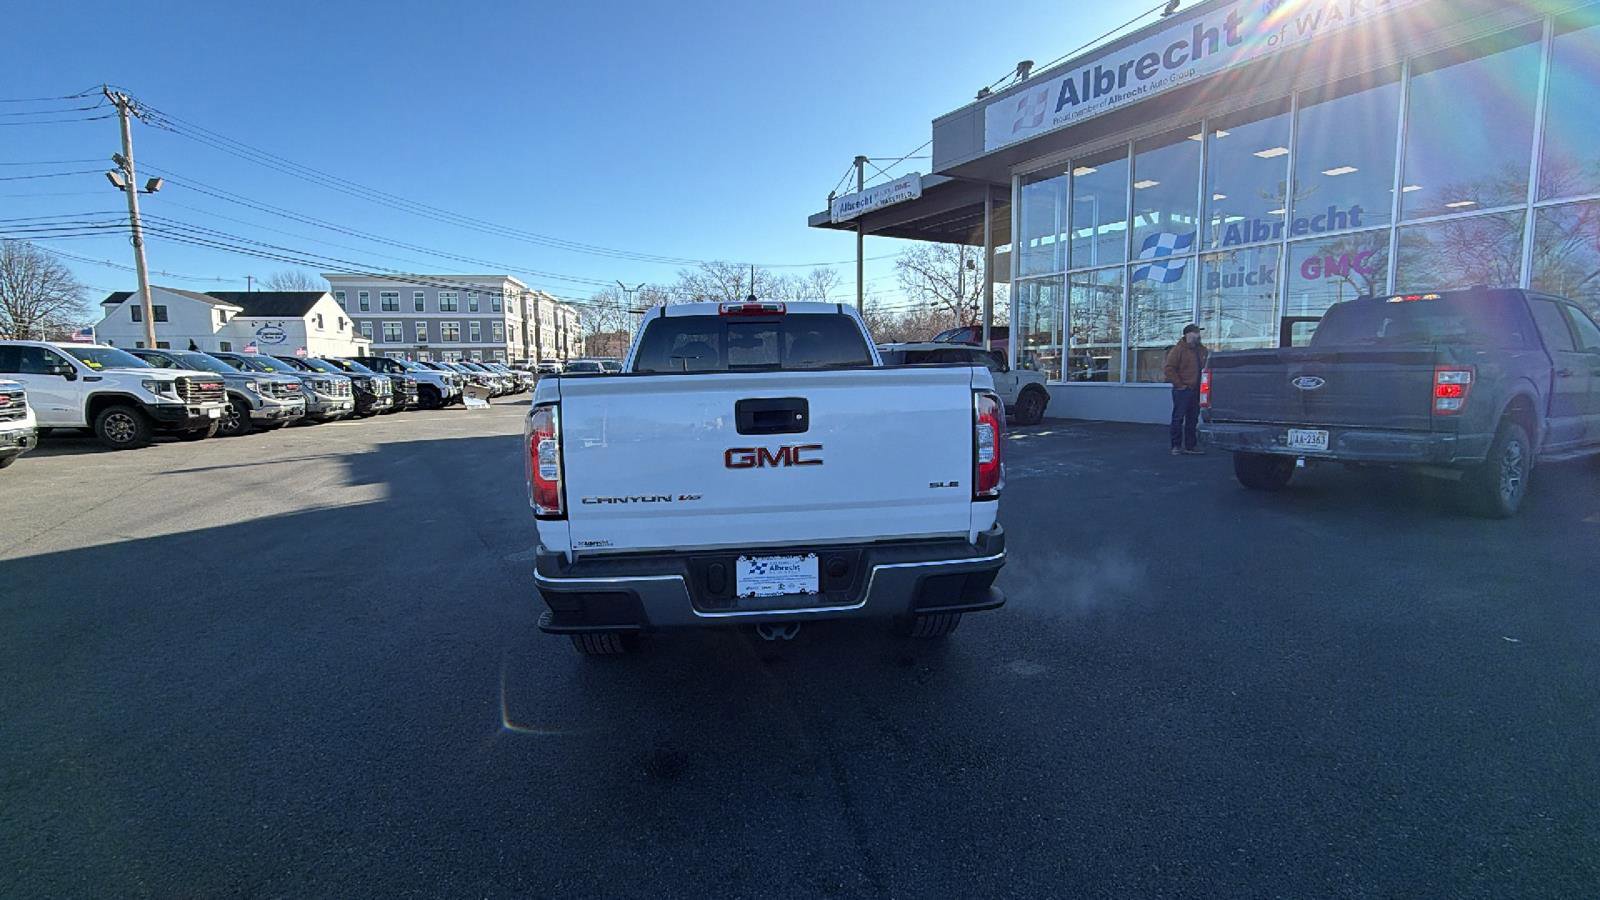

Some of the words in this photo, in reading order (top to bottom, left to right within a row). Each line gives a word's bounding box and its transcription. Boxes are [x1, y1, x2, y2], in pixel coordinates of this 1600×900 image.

[1267, 24, 1287, 46] of
[1054, 8, 1244, 114] Albrecht
[1053, 113, 1071, 125] Proud
[1071, 103, 1099, 120] member
[1099, 99, 1108, 108] of
[1108, 84, 1148, 106] Albrecht
[1150, 77, 1169, 91] Auto
[1169, 67, 1196, 84] Group
[840, 194, 873, 214] Albrecht
[1222, 204, 1364, 248] Albrecht
[1206, 265, 1275, 290] Buick
[1301, 251, 1373, 281] GMC
[724, 444, 823, 469] GMC
[929, 481, 959, 489] SLE
[581, 494, 672, 505] CANYON
[769, 564, 801, 572] Albrecht
